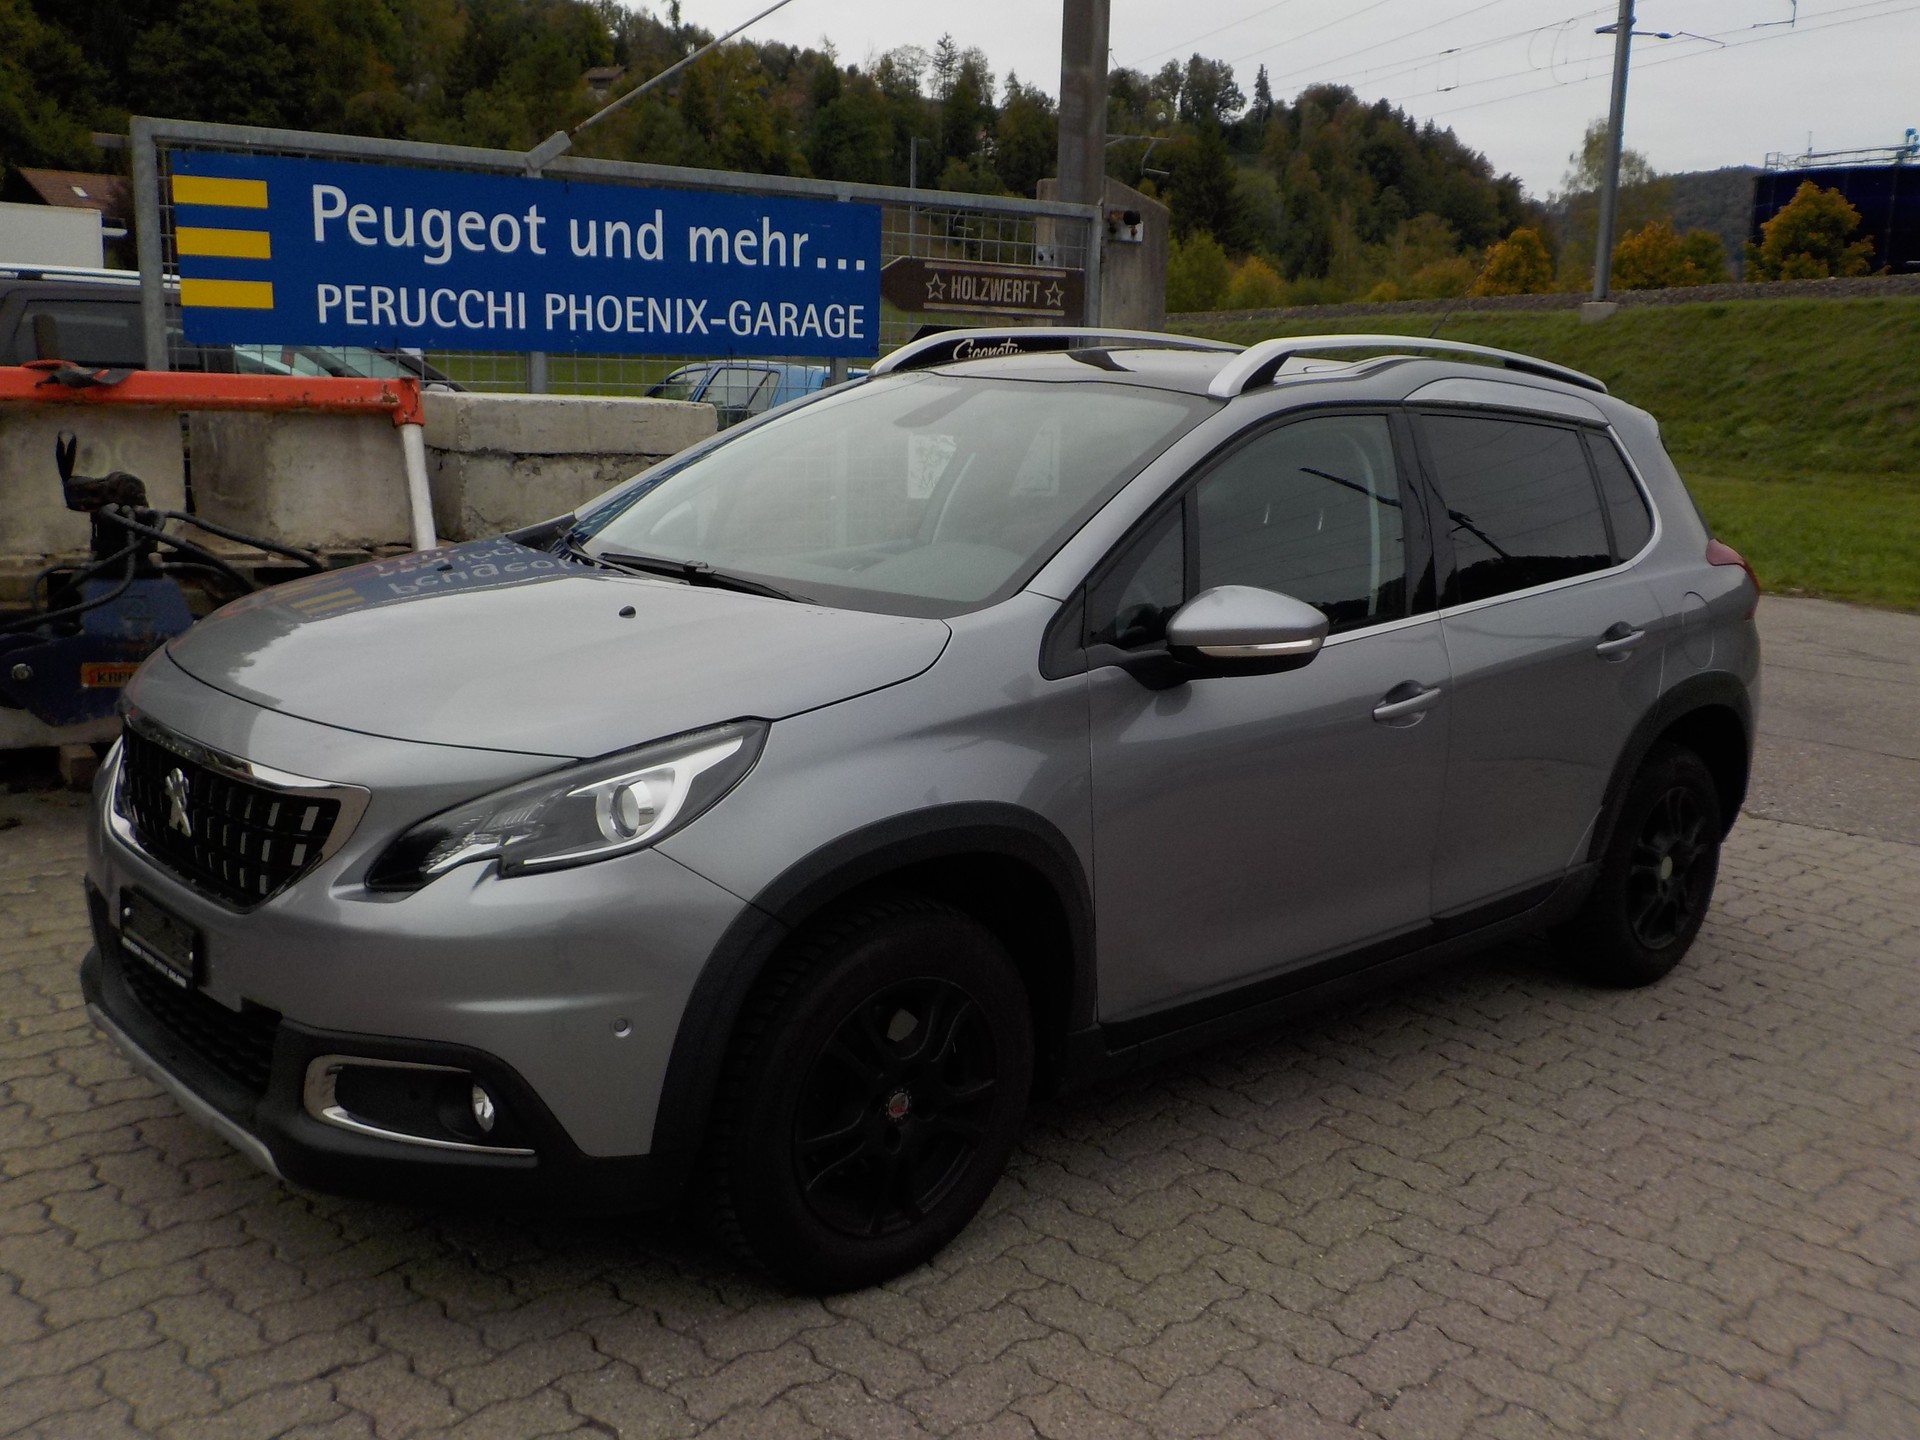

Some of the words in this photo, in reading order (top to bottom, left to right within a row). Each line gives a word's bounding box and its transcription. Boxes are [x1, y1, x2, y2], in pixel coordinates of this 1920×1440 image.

[312, 184, 547, 265] Peugeot
[569, 209, 664, 260] und
[689, 216, 865, 270] mehr...
[317, 283, 526, 329] PERUCCHI
[545, 293, 864, 339] PHOENIX-GARAGE
[951, 275, 1041, 304] HOLZWERFT
